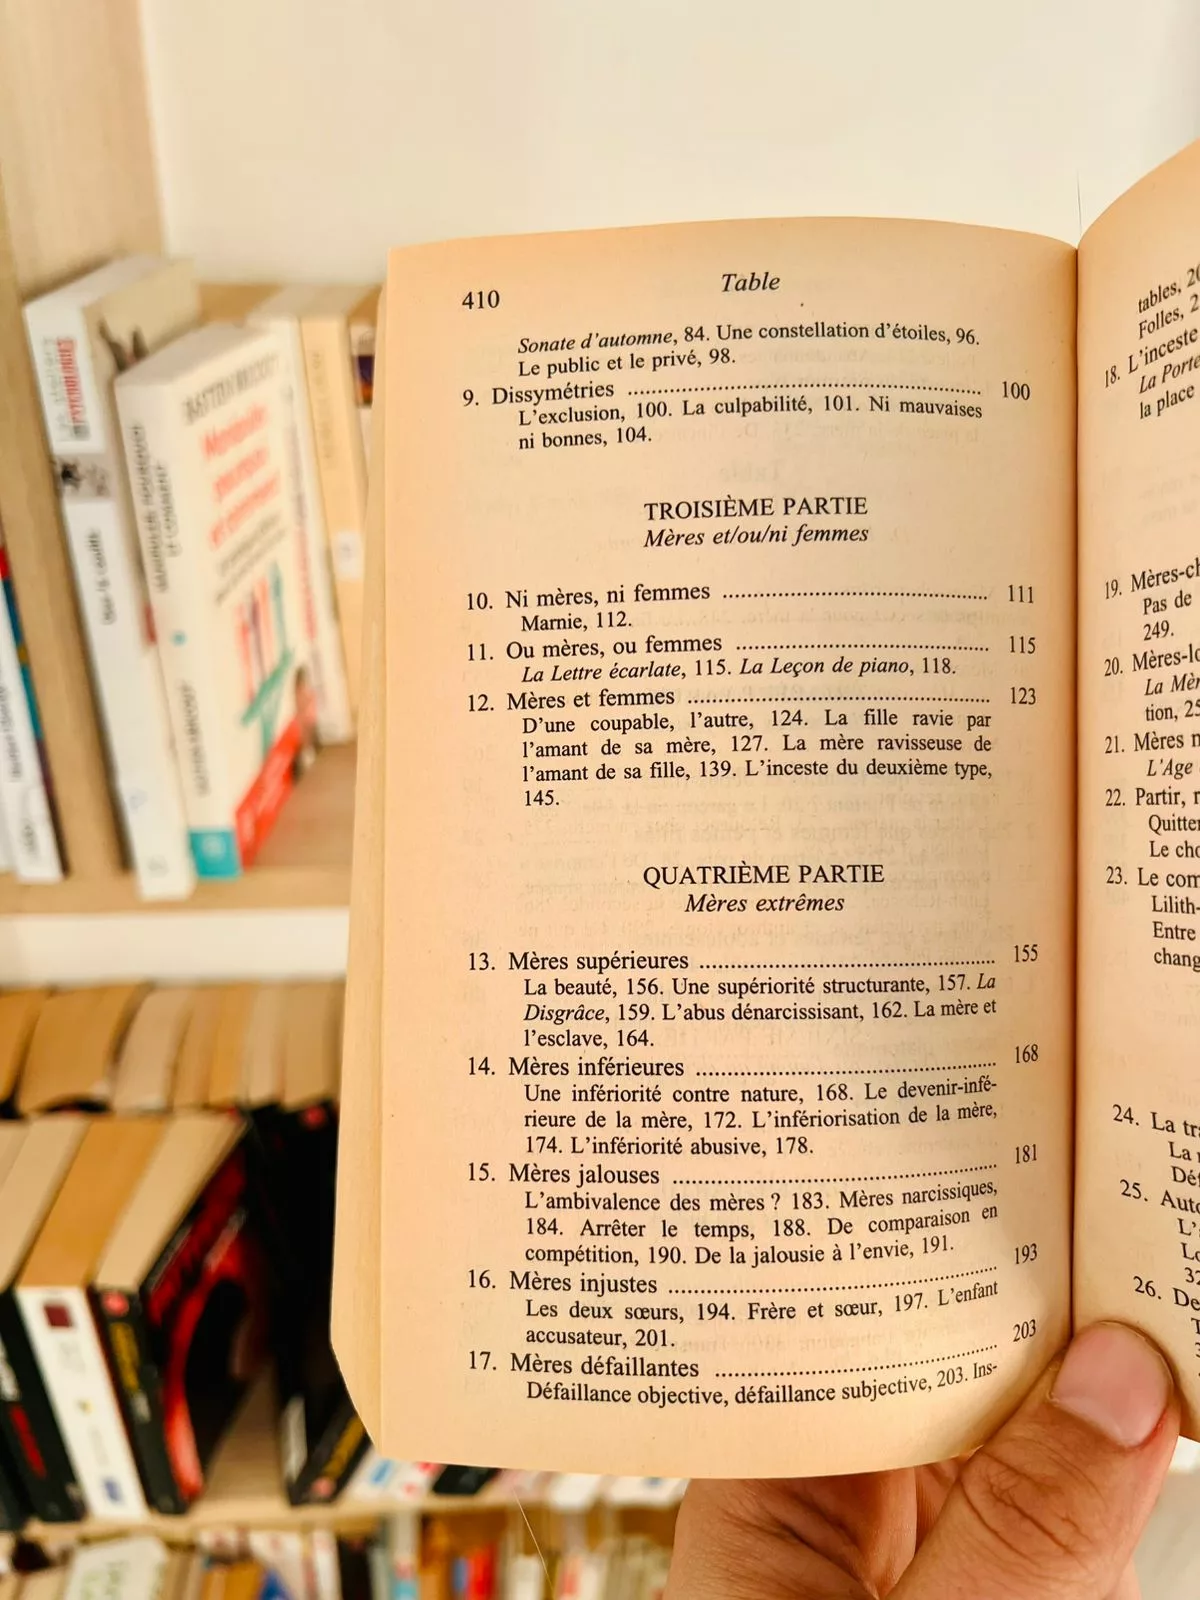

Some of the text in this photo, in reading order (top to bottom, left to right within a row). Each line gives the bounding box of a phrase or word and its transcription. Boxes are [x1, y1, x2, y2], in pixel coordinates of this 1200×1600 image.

[721, 271, 781, 293] Table
[461, 289, 501, 310] 410
[1137, 281, 1182, 314] tables,
[1138, 307, 1185, 341] Folles,
[517, 321, 980, 354] Sonate d’automne, 84. Une constellation d’étoiles, 96.
[518, 347, 736, 380] Le public et le privé, 98.
[1105, 364, 1121, 389] 18.
[1138, 374, 1157, 395] La
[462, 380, 1031, 407] 9. Dissymétries 100
[1139, 384, 1195, 420] la place
[518, 425, 652, 450] ni bonnes, 104.
[643, 493, 869, 521] TROISIÈME PARTIE
[642, 523, 870, 548] Mères et/ou/ni femmes
[467, 583, 1034, 611] 10. Ni mères, ni femmes 111
[1105, 578, 1123, 600] 19.
[1142, 588, 1193, 616] Pas de
[520, 610, 633, 633] Marnie, 112.
[1143, 619, 1175, 642] 249.
[467, 634, 1036, 662] 11. Ou mères, ou femmes 115
[520, 655, 956, 683] La Lettre écarlate, 115. La Leçon de piano, 118.
[1104, 656, 1124, 677] 20.
[468, 686, 1037, 713] 12. Mères et femmes 123
[1143, 677, 1164, 697] La
[1144, 703, 1179, 723] tion,
[1104, 730, 1185, 755] 21. Mères
[524, 789, 560, 807] 145.
[1105, 785, 1186, 809] 22. Partir,
[1148, 839, 1170, 858] Le
[642, 859, 885, 890] QUATRIÈME PARTIE
[1105, 865, 1128, 886] 23.
[1136, 866, 1160, 887] Le
[683, 892, 845, 913] Mères extrêmes
[1152, 920, 1197, 942] Entre
[468, 943, 1038, 975] 13. Mères supérieures 155
[523, 972, 996, 1000] La beauté, 156. Une supériorité structurante, 157. La
[523, 1028, 655, 1051] l’esclave, 164.
[468, 1043, 1039, 1077] 14. Mères inférieures 168
[1112, 1103, 1177, 1134] 24. La
[1167, 1140, 1193, 1162] La
[468, 1143, 1038, 1189] 15. Mères jalouses 181
[1119, 1178, 1149, 1202] 25.
[527, 1205, 998, 1243] 184. Arrêter le temps, 188. De comparaison en
[468, 1242, 1038, 1298] 16. Mères injustes 193
[1132, 1275, 1162, 1300] 26.
[469, 1318, 1037, 1378] 17. Mères défaillantes 203
[525, 1328, 676, 1351] accusateur, 201.
[526, 1362, 998, 1409] Défaillance objective, défaillance subjective, 203. Ins-
